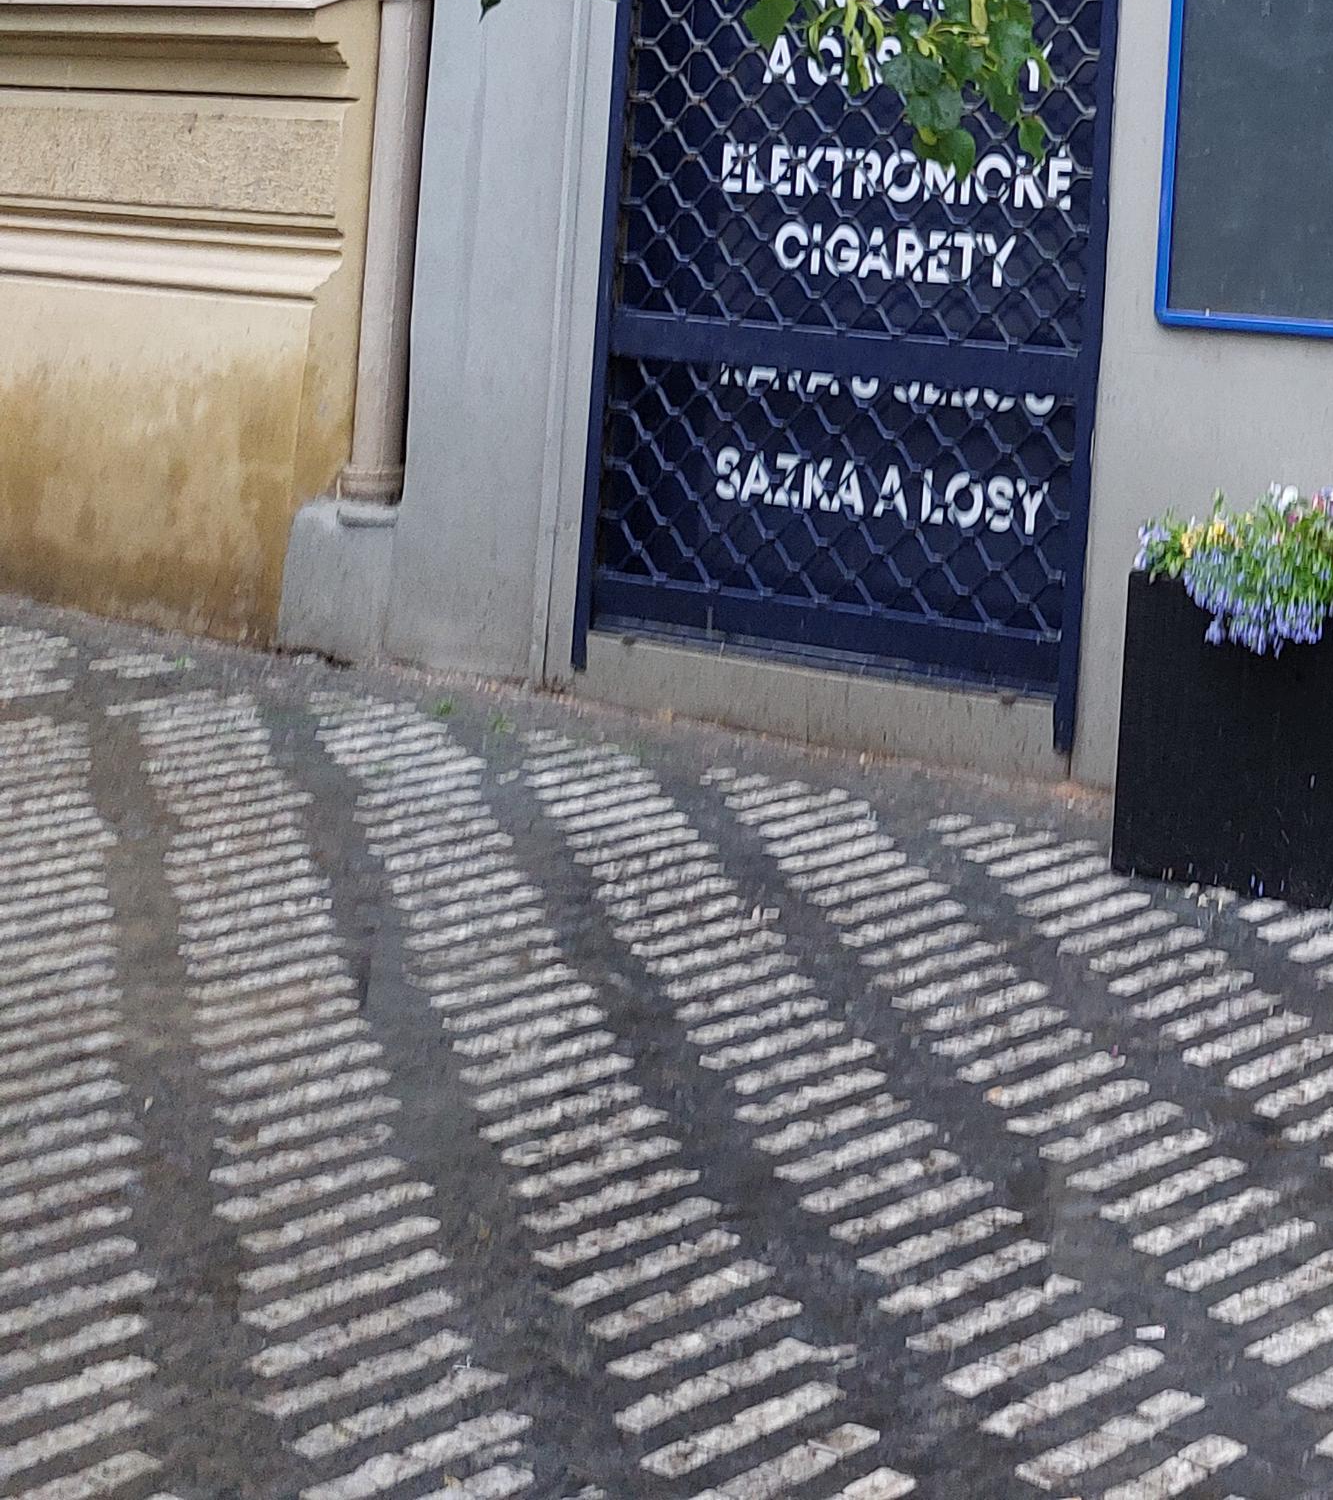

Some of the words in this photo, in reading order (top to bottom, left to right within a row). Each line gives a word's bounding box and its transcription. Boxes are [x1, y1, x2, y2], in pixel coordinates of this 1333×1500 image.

[762, 35, 797, 85] A
[773, 220, 1017, 288] CIGARETY
[715, 445, 865, 517] SAZKA
[872, 464, 908, 522] A
[920, 467, 1050, 535] LOSY
